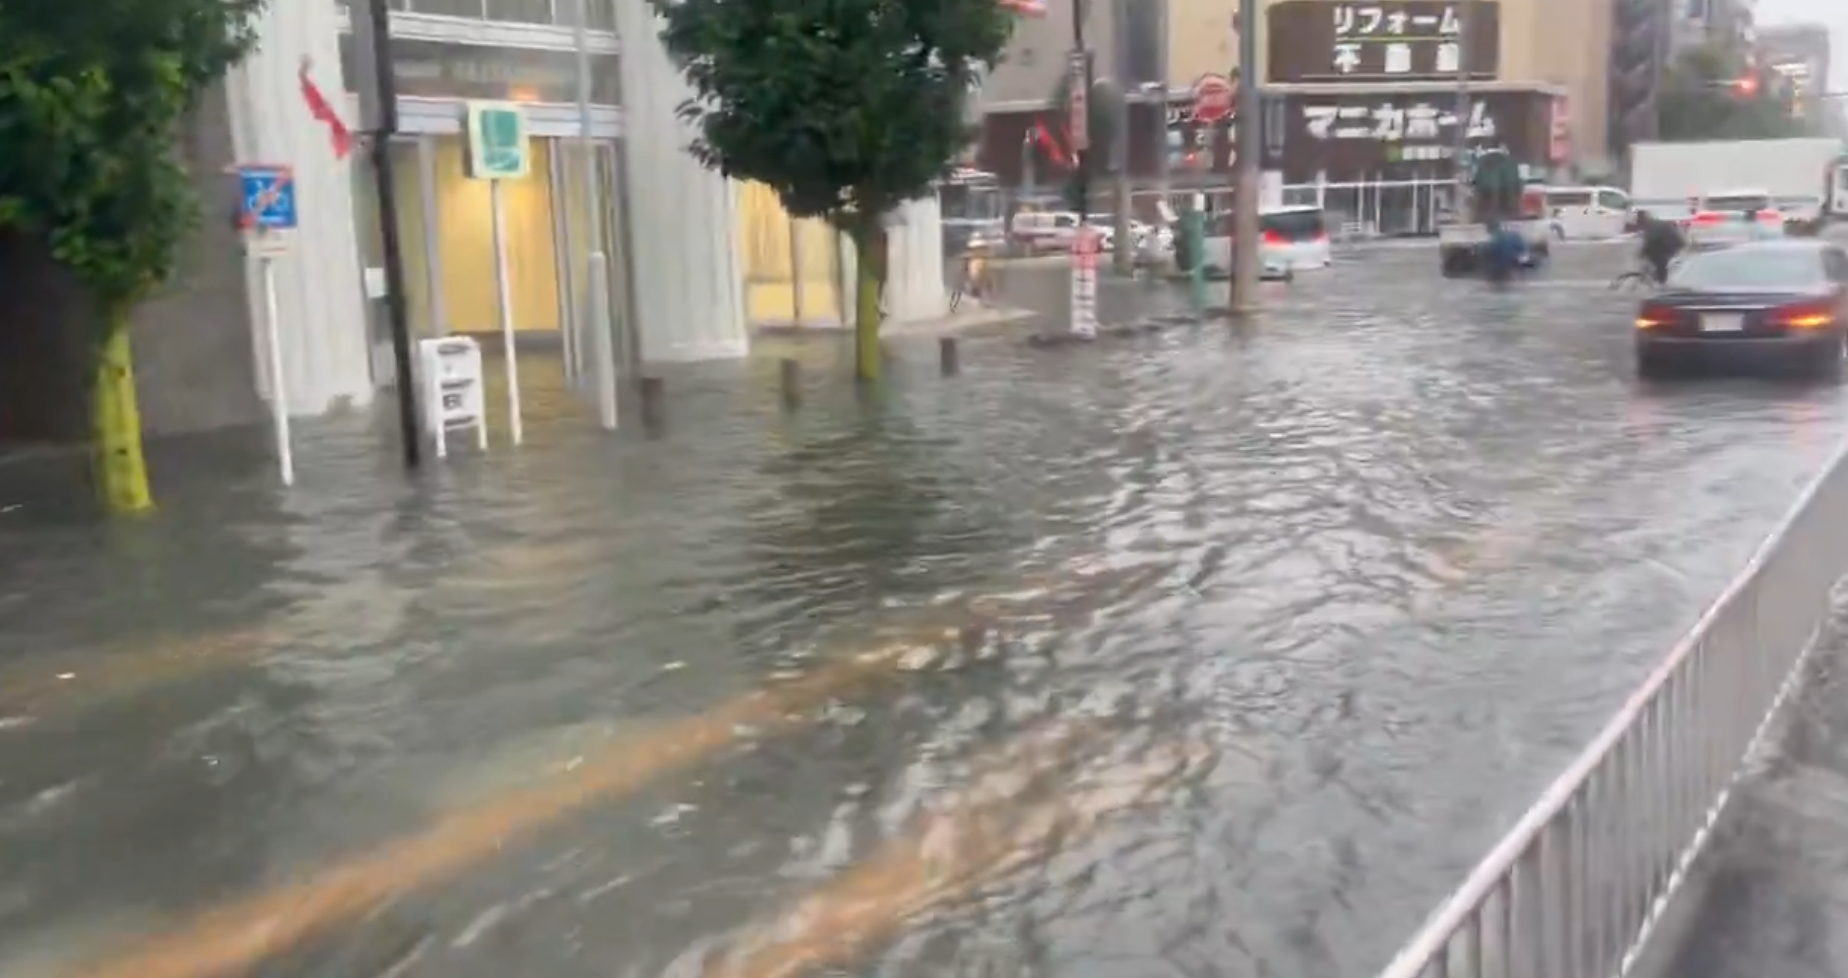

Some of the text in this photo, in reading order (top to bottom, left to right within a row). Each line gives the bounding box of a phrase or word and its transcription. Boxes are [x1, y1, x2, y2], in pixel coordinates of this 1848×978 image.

[1333, 6, 1460, 34] リフォーム
